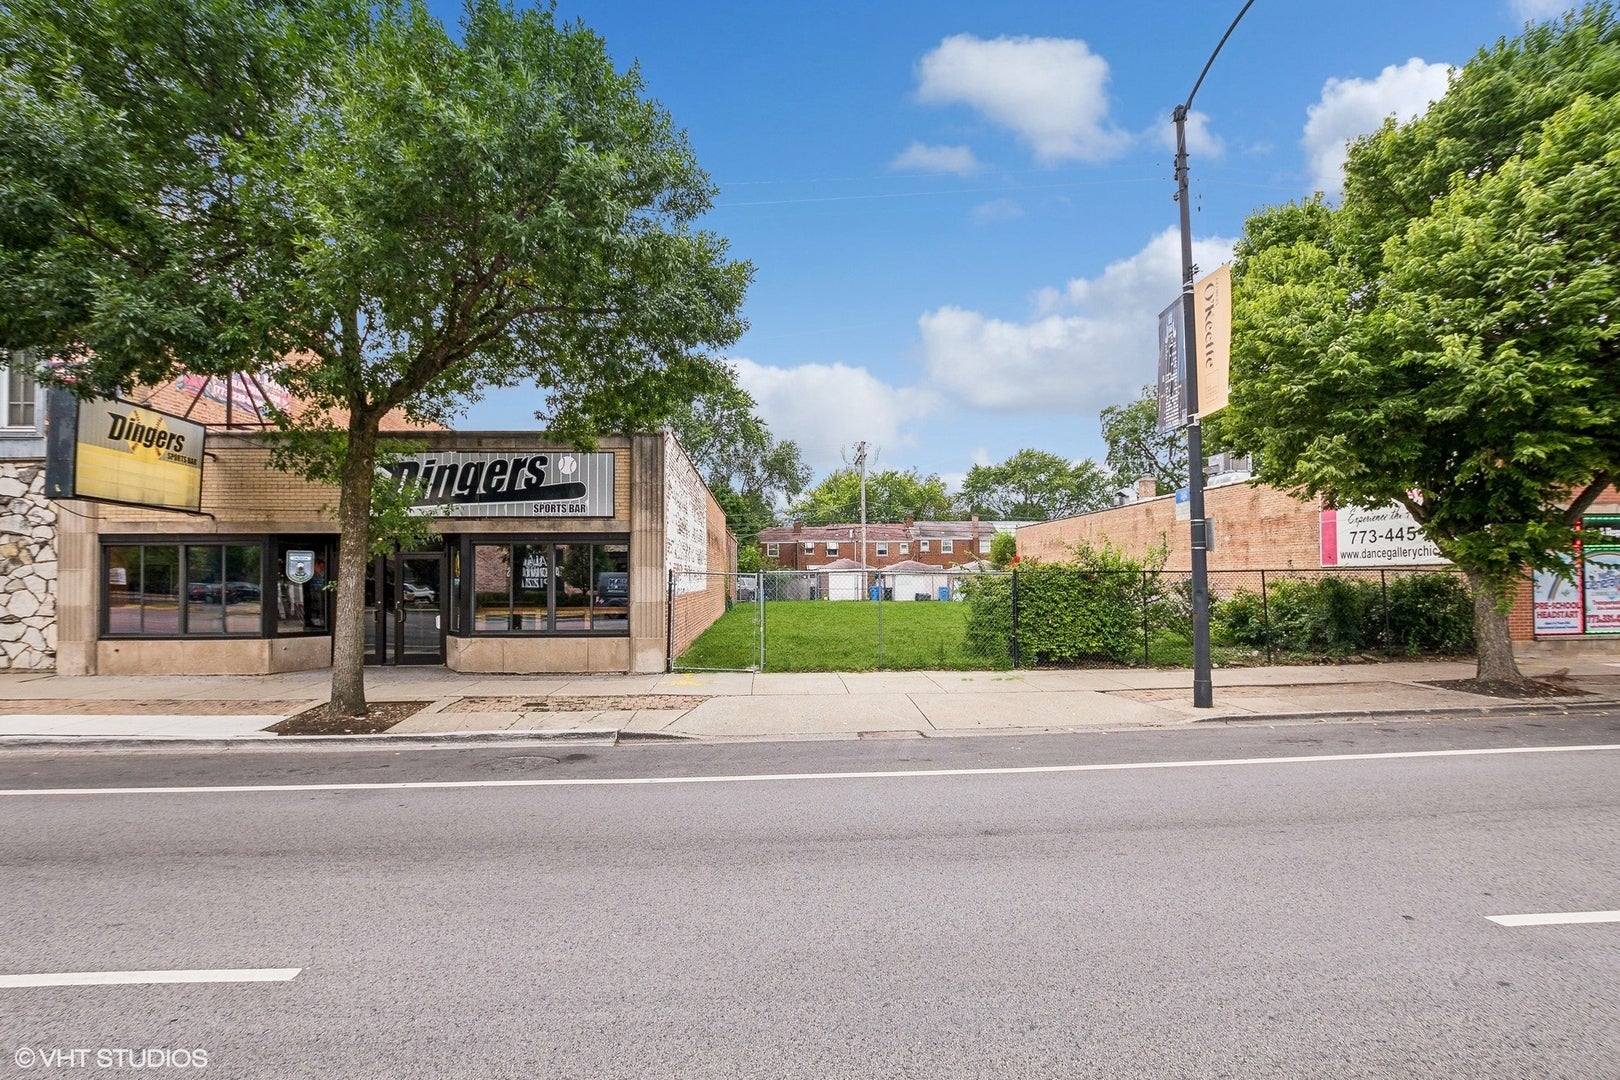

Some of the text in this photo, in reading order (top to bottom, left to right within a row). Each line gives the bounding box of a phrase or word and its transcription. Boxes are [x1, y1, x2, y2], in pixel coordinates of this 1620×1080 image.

[107, 412, 186, 453] Dingers
[167, 452, 197, 466] SPORTS BAR
[384, 455, 549, 502] Dingers
[533, 503, 586, 514] SPORTS BAR
[1348, 508, 1388, 527] Experience
[1536, 611, 1578, 619] HEADSTART
